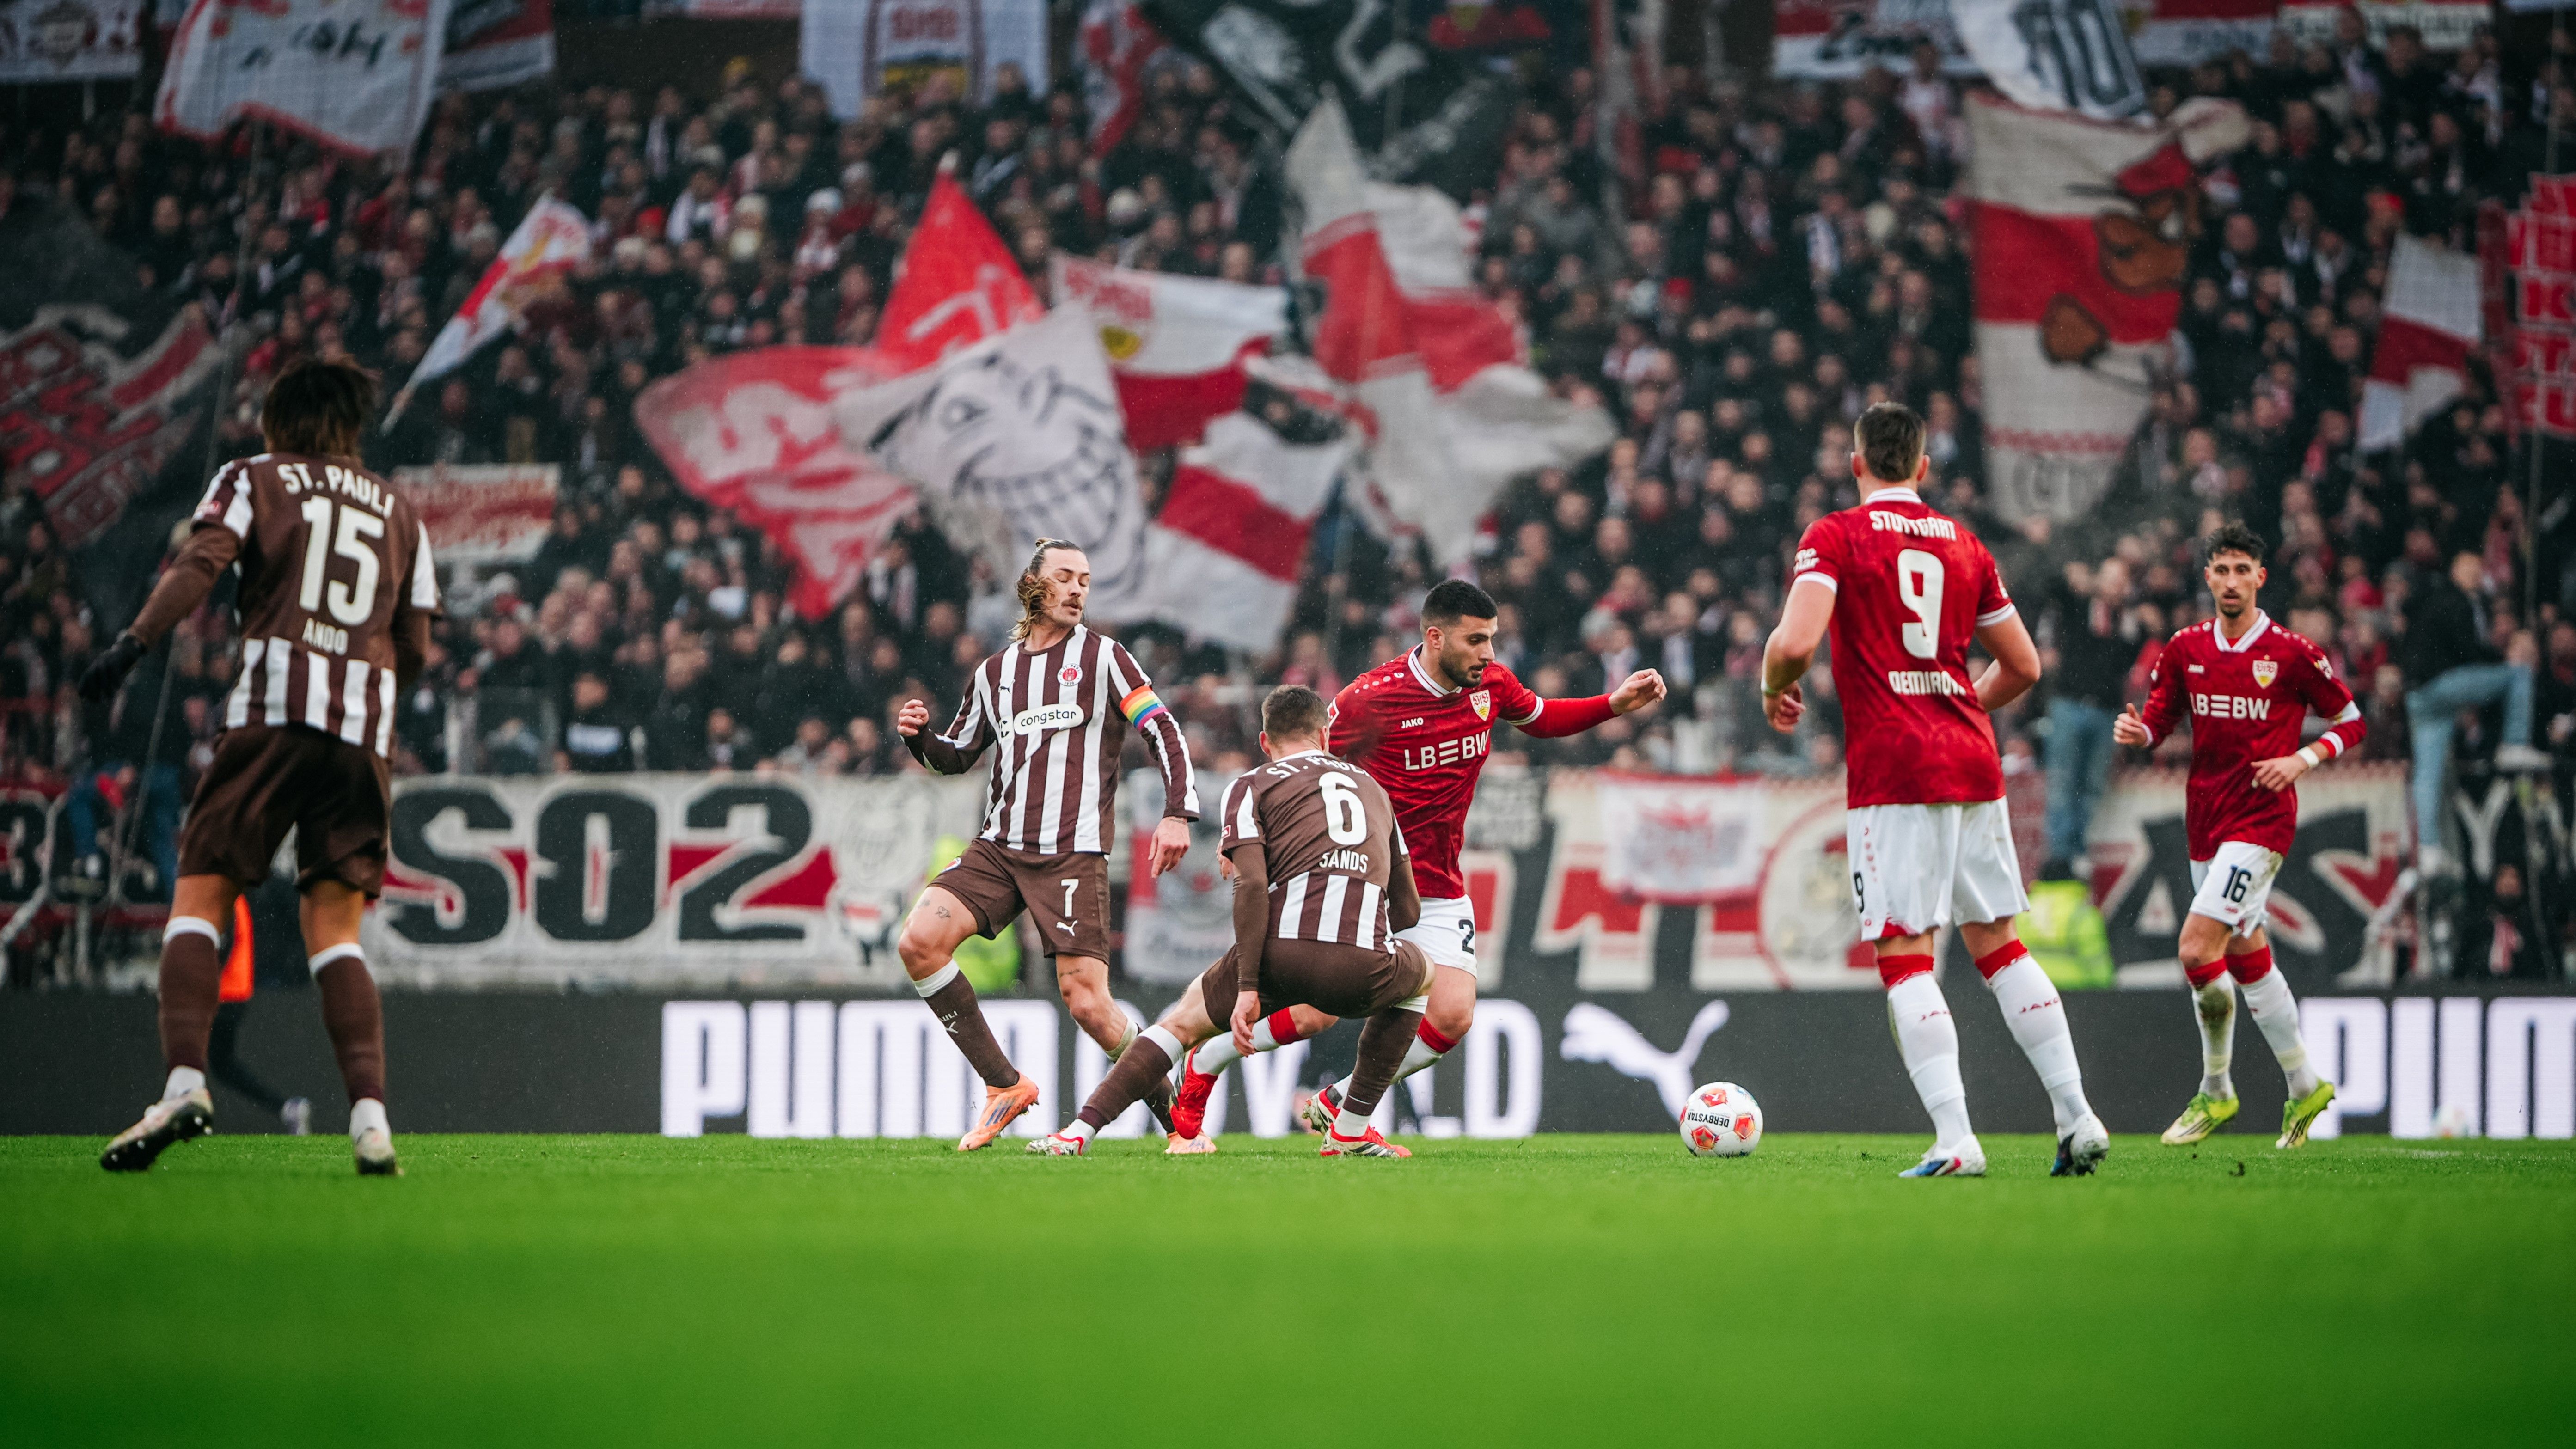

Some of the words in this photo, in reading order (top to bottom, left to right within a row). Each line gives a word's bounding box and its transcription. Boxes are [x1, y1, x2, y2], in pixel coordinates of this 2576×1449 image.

[277, 463, 324, 495] ST.
[324, 465, 396, 519] PAULI
[1868, 510, 1957, 542] STUTTGART
[299, 495, 385, 626] 15
[1897, 548, 1945, 660] 9
[301, 618, 349, 656] ANDO
[1021, 709, 1077, 727] congstar
[1401, 717, 1424, 729] JAKO
[1266, 762, 1309, 779] ST.
[1318, 771, 1367, 845] 6
[1319, 849, 1369, 874] SANDS
[1061, 878, 1079, 917] 7
[1854, 870, 1865, 914] 9
[2221, 864, 2252, 903] 16
[661, 1000, 1059, 1138] PUMA
[1687, 1111, 1730, 1128] DERBYSTAR
